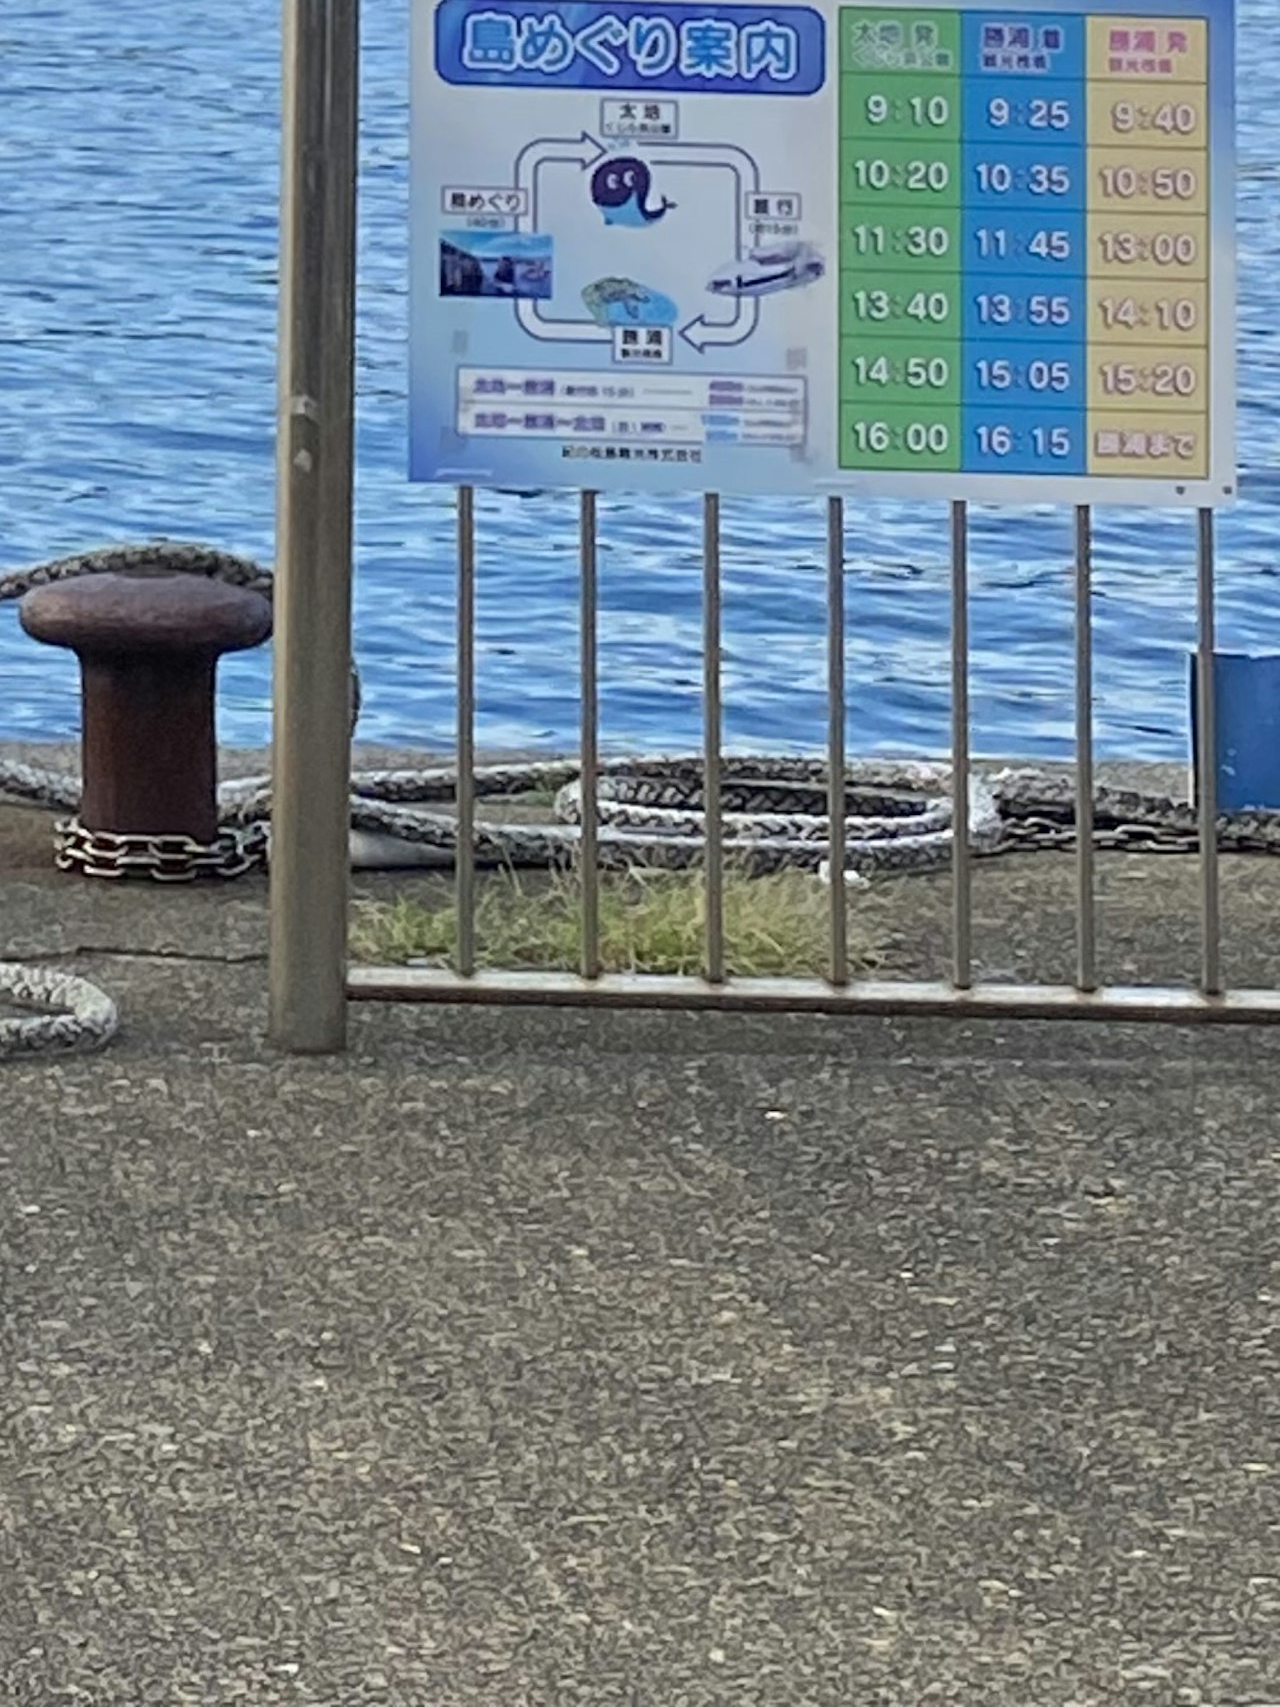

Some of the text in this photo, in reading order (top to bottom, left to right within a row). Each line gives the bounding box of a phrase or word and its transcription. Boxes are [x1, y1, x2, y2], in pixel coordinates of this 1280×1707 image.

[462, 9, 800, 80] 島めぐり案内
[866, 94, 1197, 134] 9:10 9:25 9:40
[853, 159, 1197, 199] 10:20 10:35 10:50
[853, 224, 1197, 265] 11:30 11:45 13:00
[852, 290, 1197, 330] 13:40 13:55 14:10
[852, 355, 1197, 396] 14:50 15:05 15:20
[852, 421, 1070, 457] 16:00 16:15
